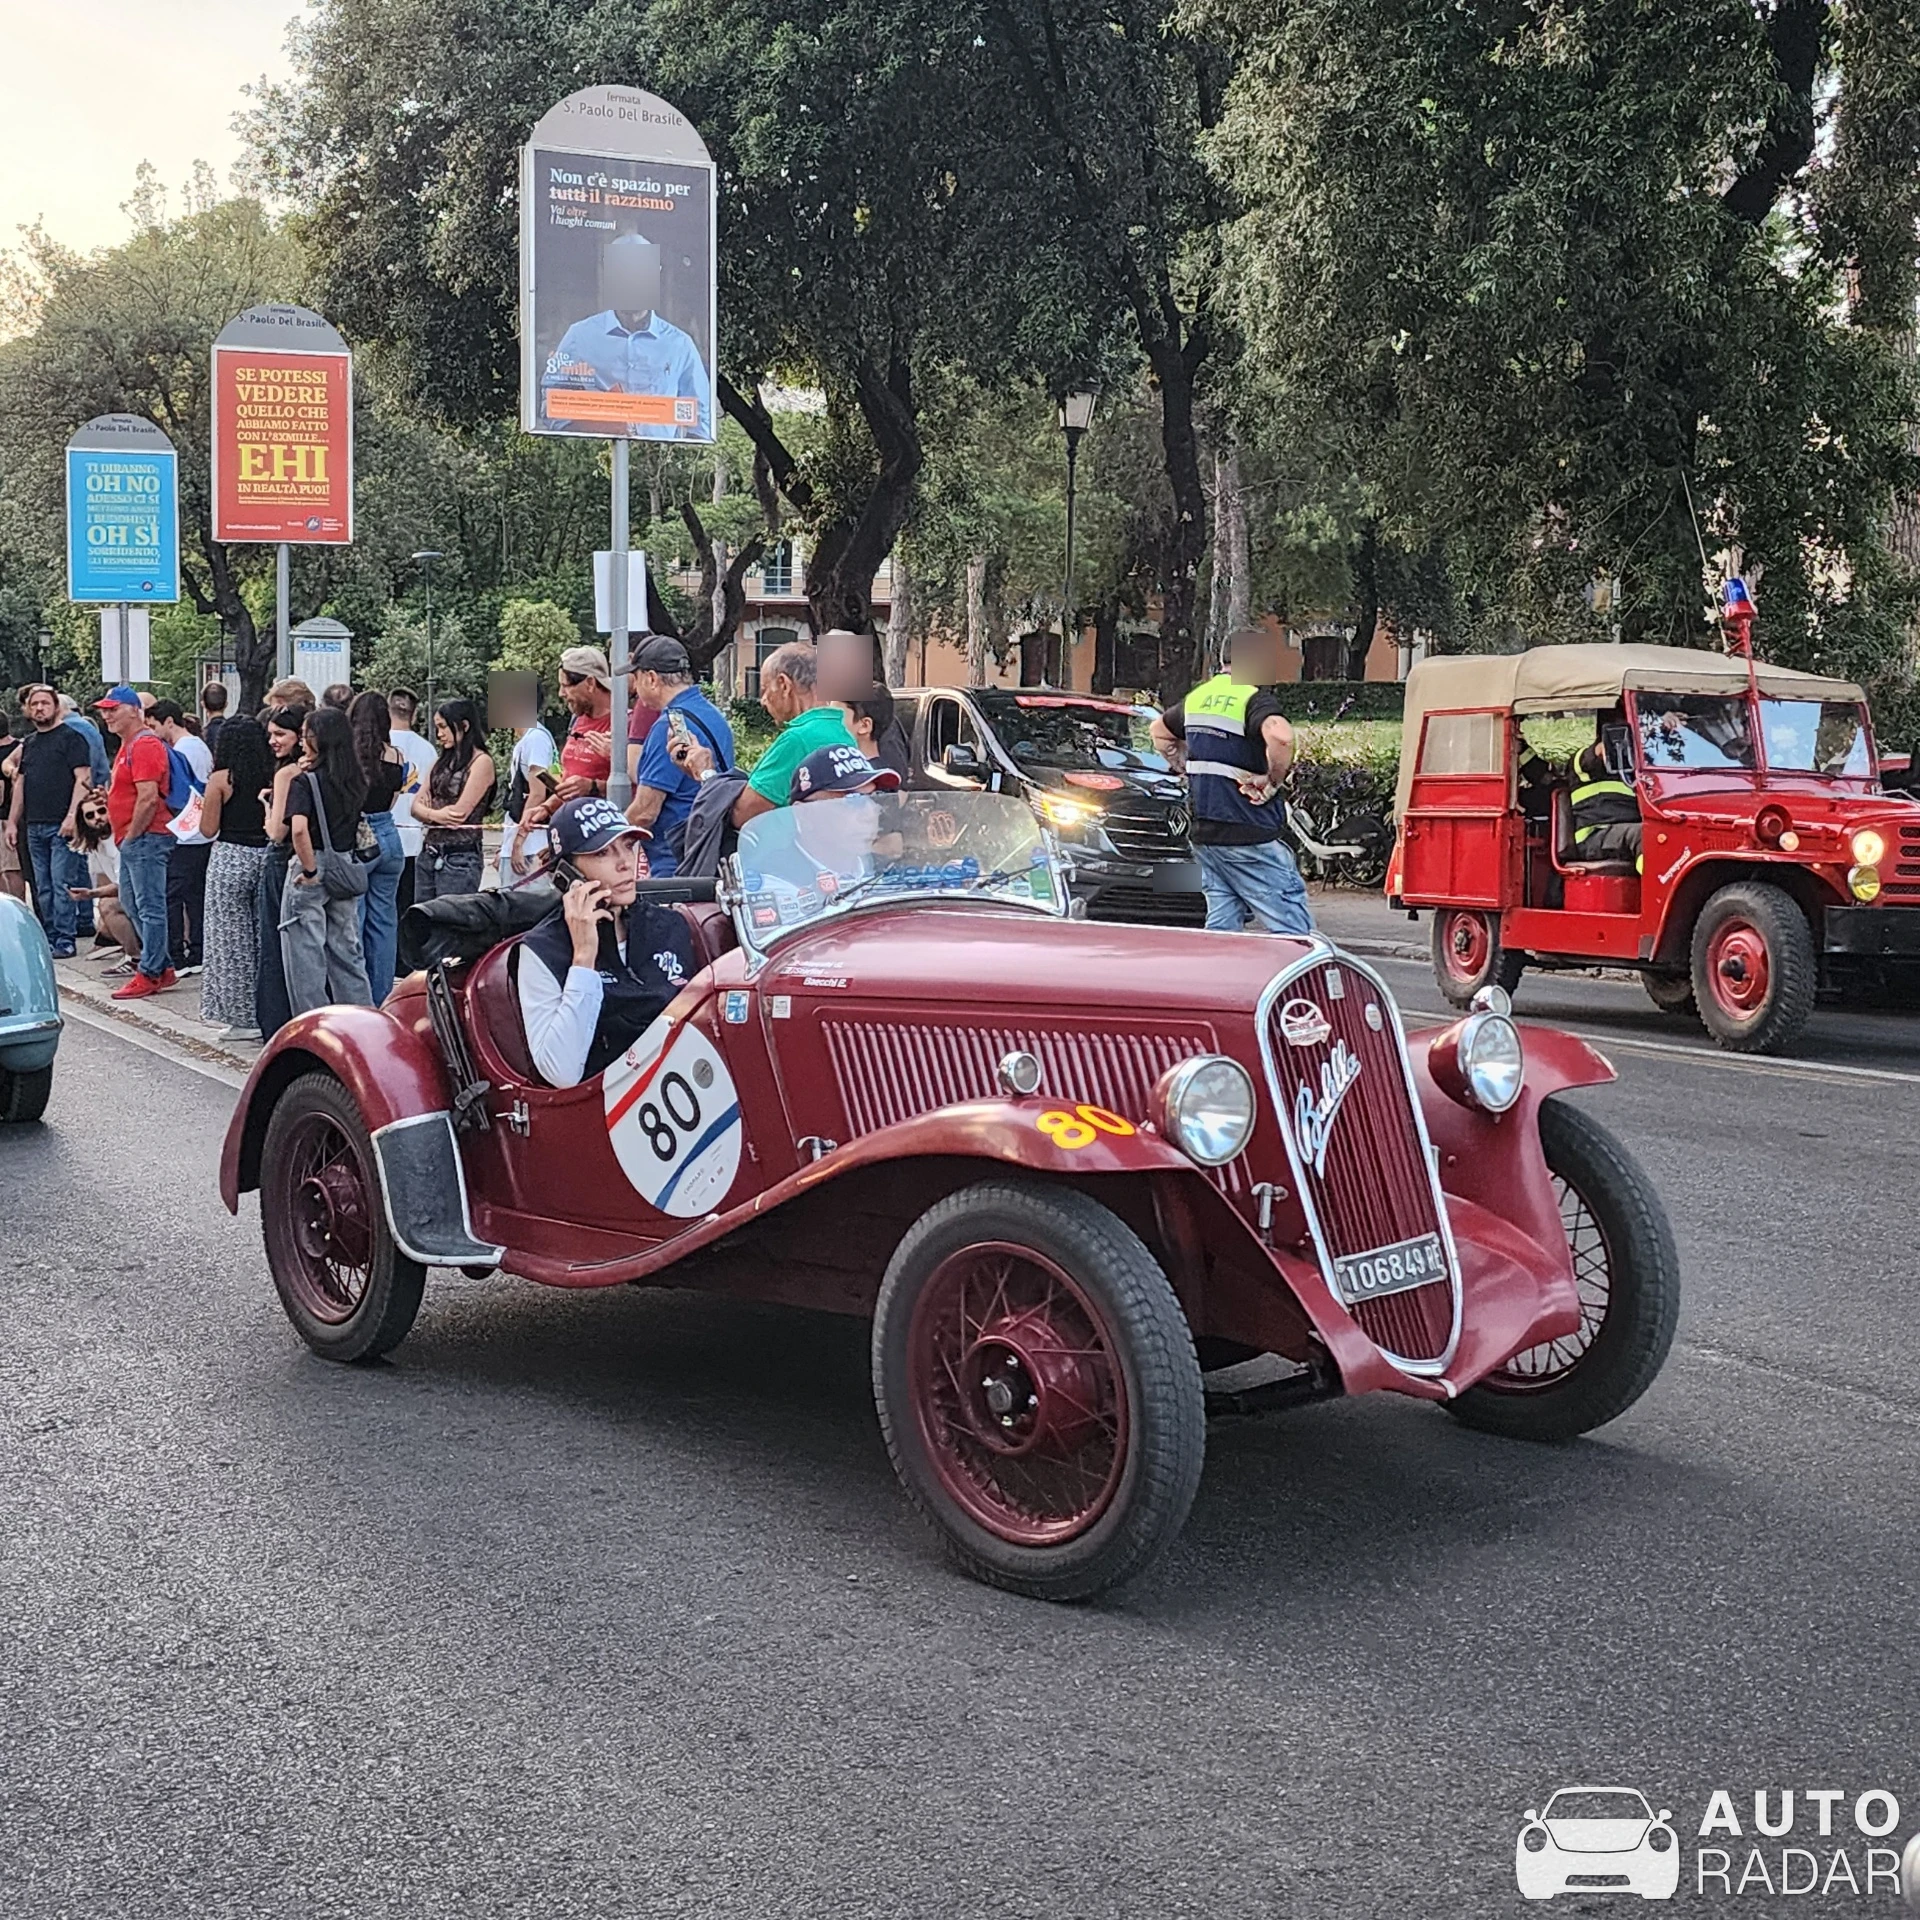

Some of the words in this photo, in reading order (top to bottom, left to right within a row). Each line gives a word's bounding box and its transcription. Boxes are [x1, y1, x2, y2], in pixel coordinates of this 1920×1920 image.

[606, 91, 641, 105] fermata
[563, 101, 574, 114] S.
[579, 102, 614, 118] Paolo
[619, 107, 637, 121] Del
[642, 111, 683, 127] Brasile
[550, 168, 582, 185] Non
[611, 177, 661, 193] spazio
[665, 183, 690, 197] per
[549, 186, 586, 202] tutti
[589, 189, 600, 203] il
[605, 193, 674, 211] razzismo
[550, 205, 566, 216] Vai
[555, 216, 583, 228] luoghi
[584, 219, 616, 230] comuni
[239, 315, 247, 323] S.
[250, 314, 276, 325] Paolo
[279, 317, 293, 326] Del
[296, 318, 327, 328] Brasile
[235, 367, 257, 382] SE
[259, 369, 328, 384] POTESSI
[235, 384, 328, 404] VEDERE
[236, 405, 295, 418] QUELLO
[297, 406, 329, 419] CHE
[95, 424, 116, 432] Paolo
[118, 425, 131, 433] Del
[236, 419, 290, 430] ABBIAMO
[292, 420, 329, 431] FATTO
[237, 432, 260, 441] CON
[85, 462, 98, 473] TI
[238, 443, 330, 483] EHI
[86, 475, 120, 492] OH
[126, 476, 161, 493] NO
[237, 483, 251, 493] IN
[253, 483, 298, 494] REALTÀ
[87, 525, 128, 546] OH
[574, 799, 618, 821] 1000
[638, 1071, 701, 1162] 80
[1035, 1104, 1136, 1150] 80
[1346, 1248, 1426, 1292] 106849
